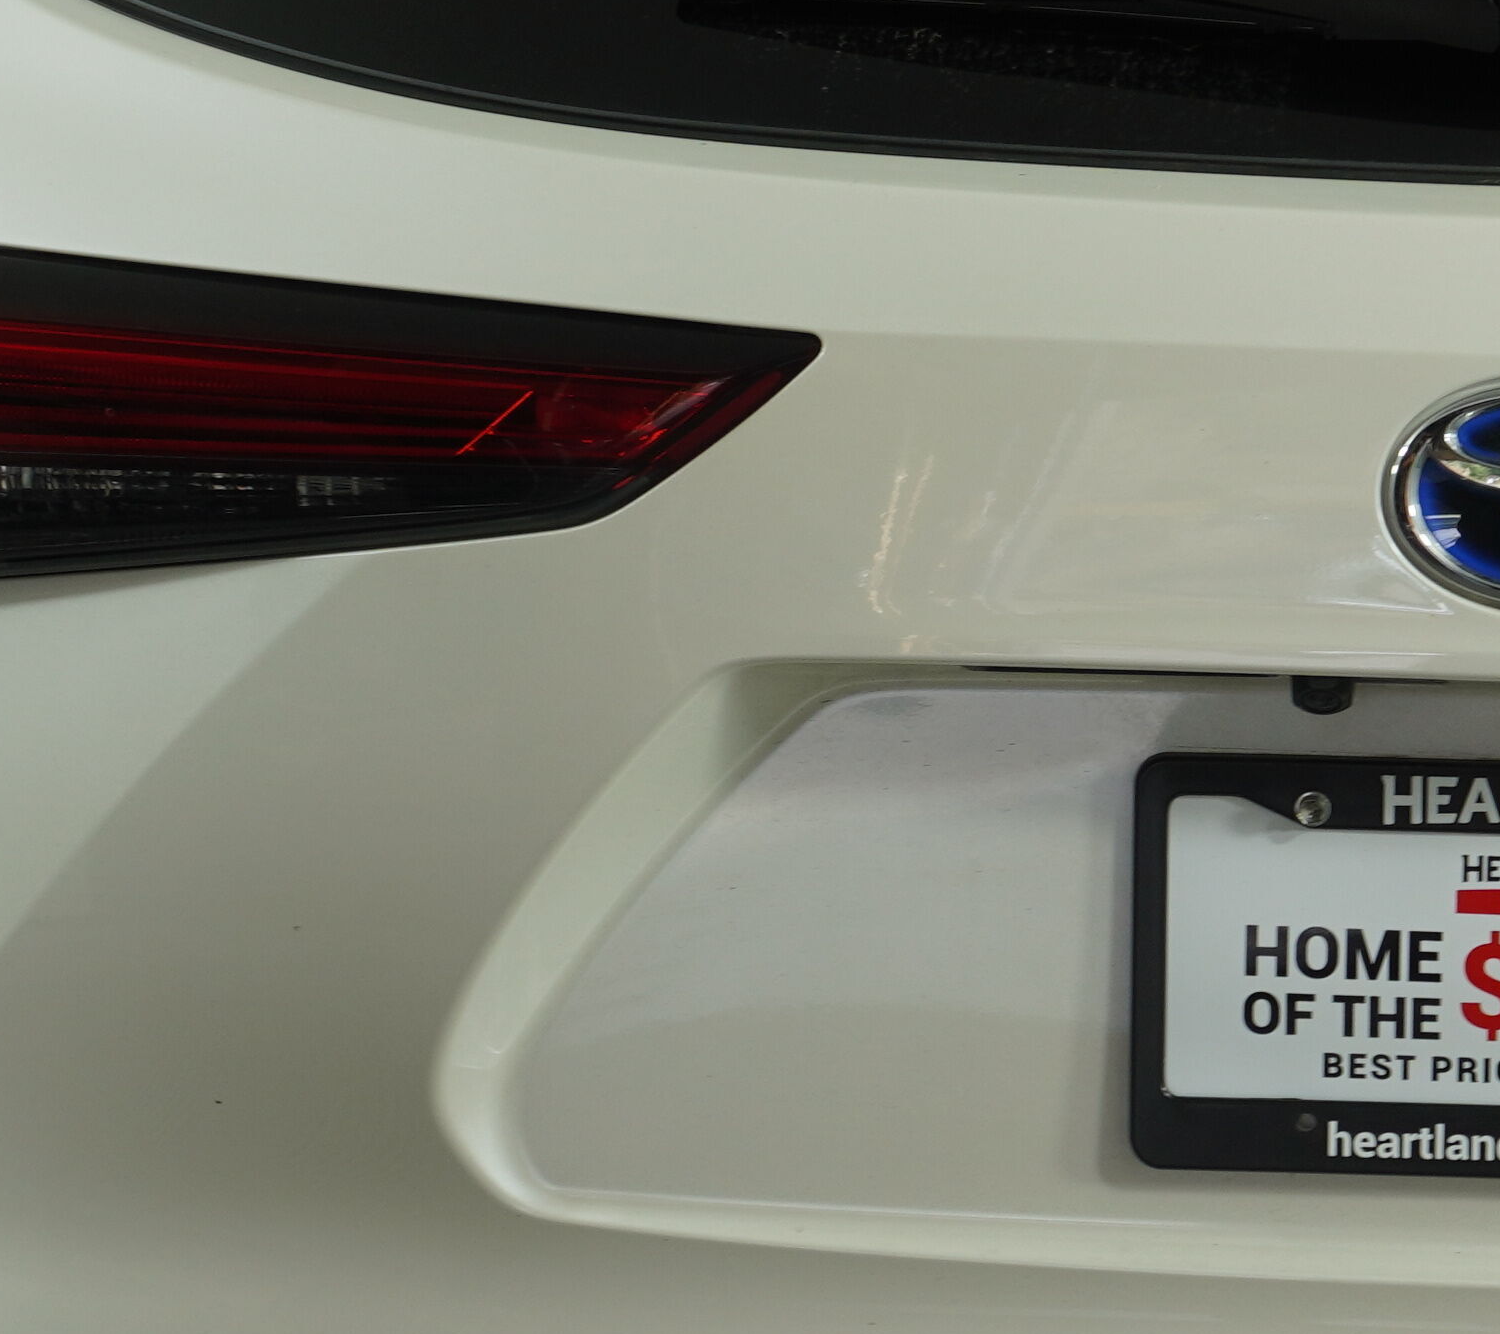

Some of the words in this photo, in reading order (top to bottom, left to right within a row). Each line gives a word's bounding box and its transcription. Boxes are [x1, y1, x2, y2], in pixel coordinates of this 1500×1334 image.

[1243, 924, 1443, 984] HOME
[1242, 990, 1316, 1036] OF
[1332, 994, 1442, 1041] THE
[1321, 1052, 1415, 1082] BEST
